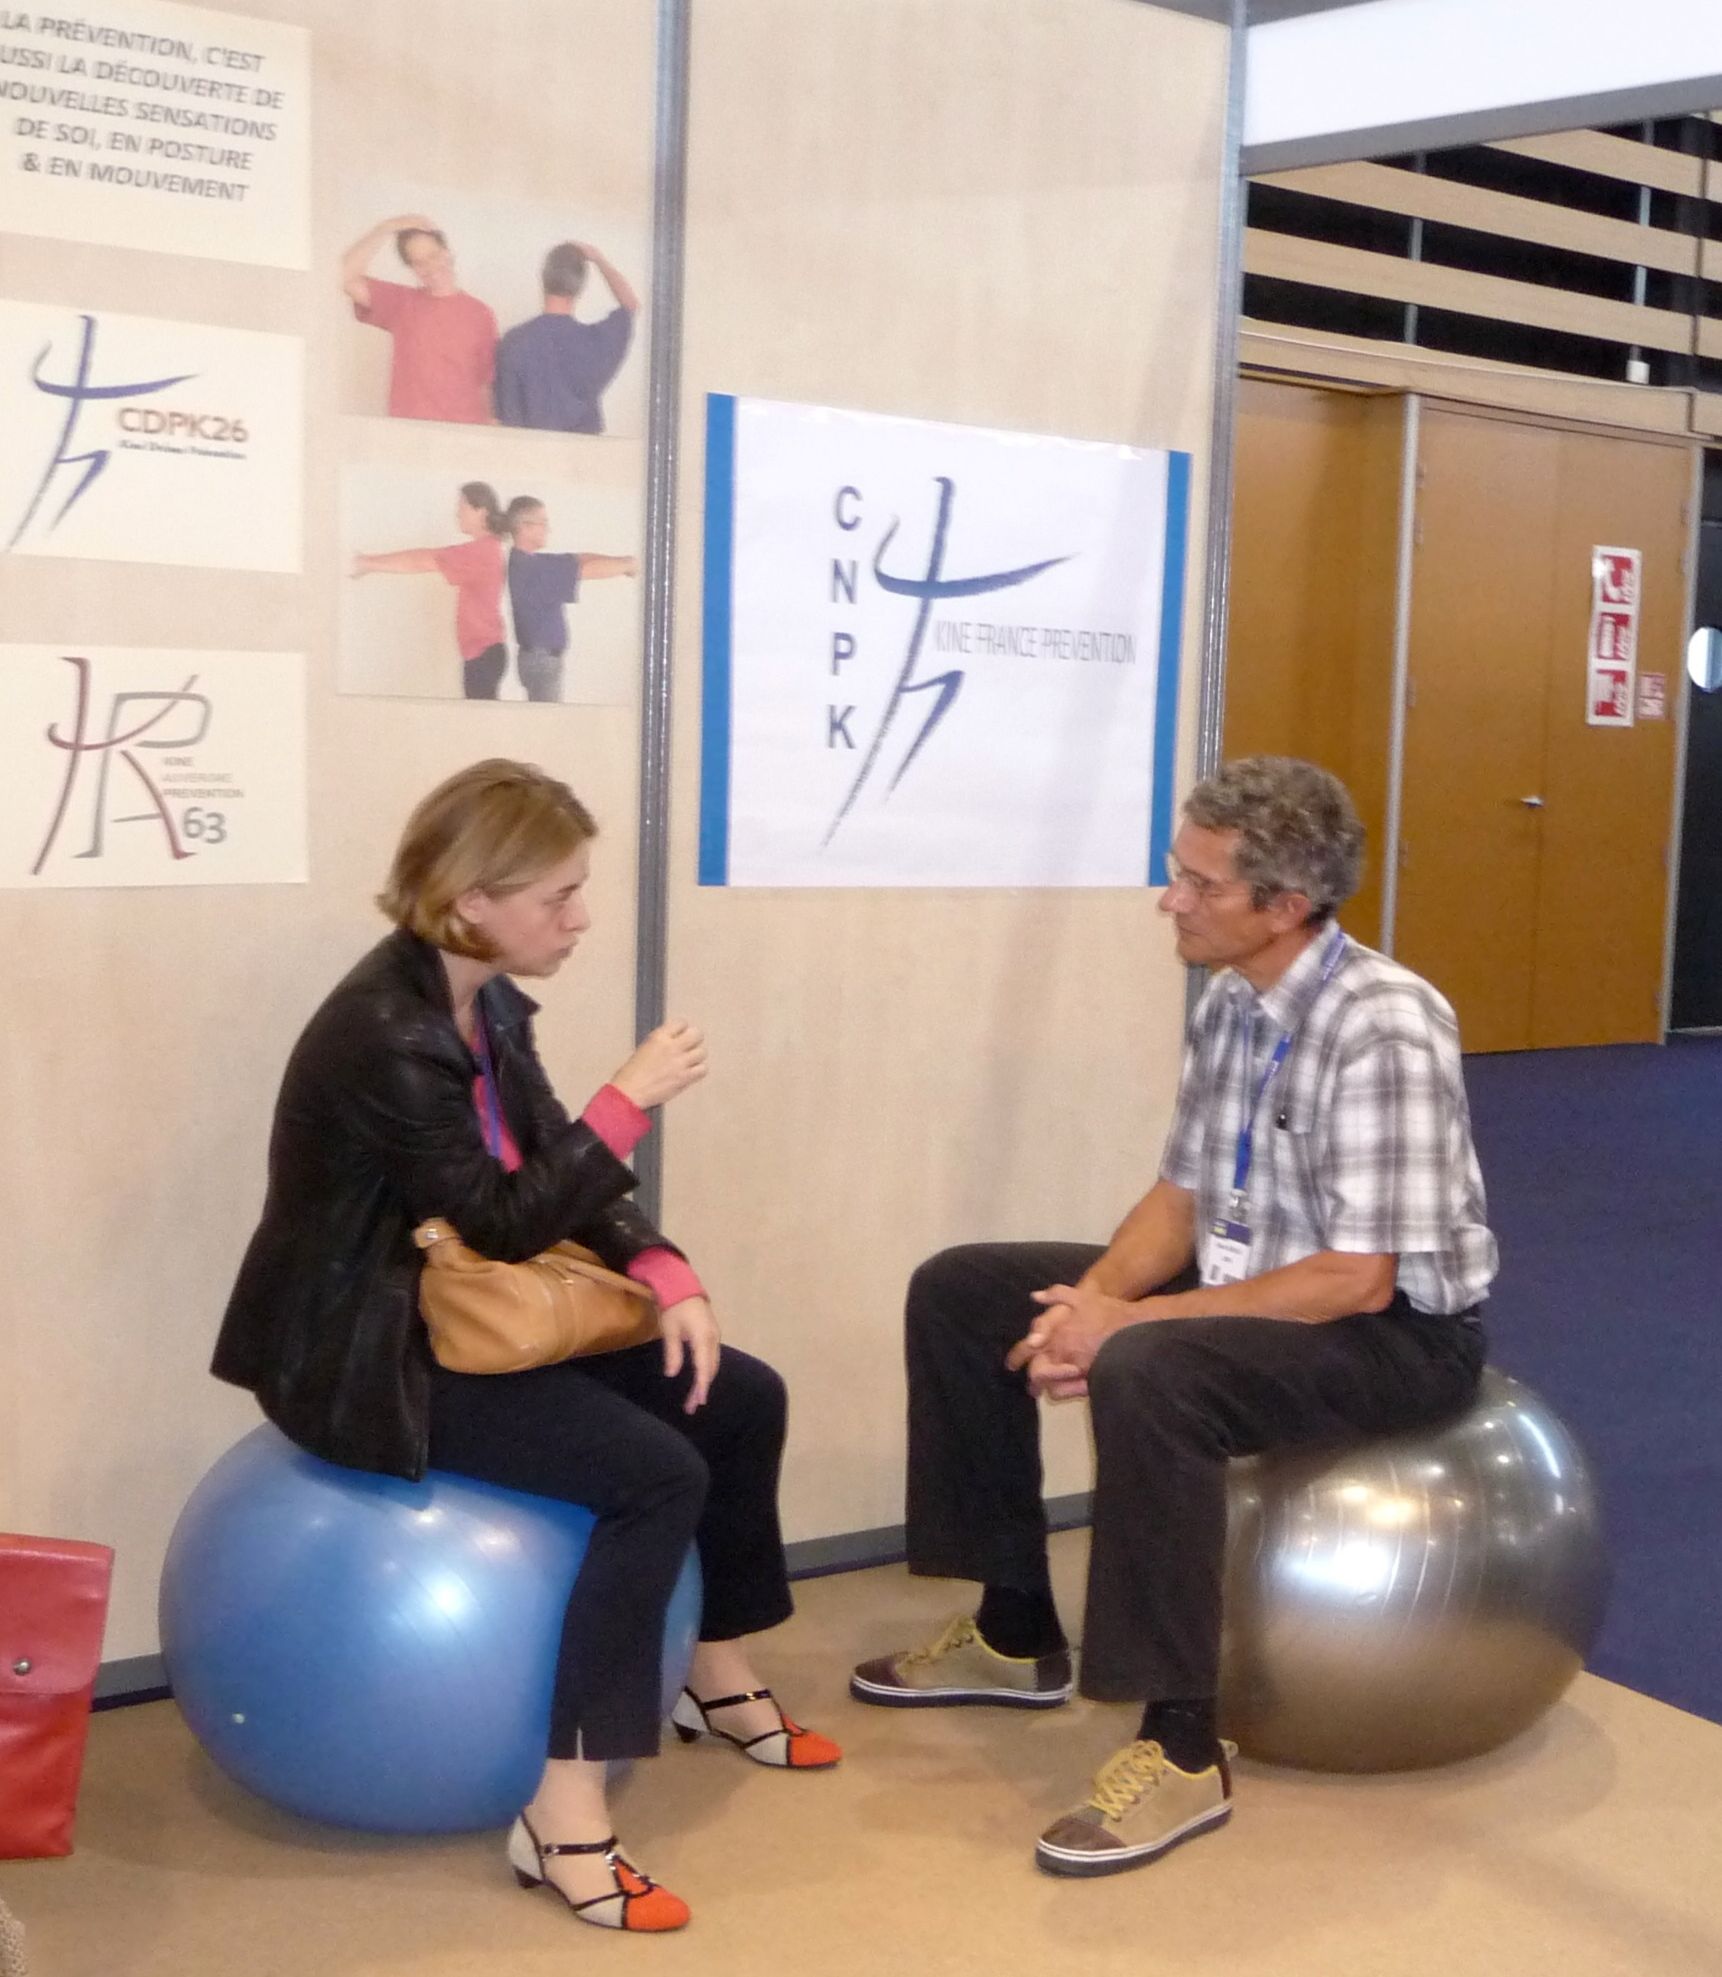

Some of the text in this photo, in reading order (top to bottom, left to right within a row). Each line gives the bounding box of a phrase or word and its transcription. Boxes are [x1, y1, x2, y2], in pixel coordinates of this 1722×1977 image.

[0, 10, 266, 72] LA PRÉVENTION, C'EST
[0, 44, 286, 110] USSI LA DÉCOUVERTE DE
[16, 117, 254, 170] DE SOI, EN POSTURE
[134, 101, 278, 141] SENSATIONS
[21, 152, 250, 202] & EN MOUVEMENT
[117, 407, 249, 443] CDPK26
[936, 620, 1137, 665] KINE FRANCE PREVENTION
[182, 806, 228, 845] 63
